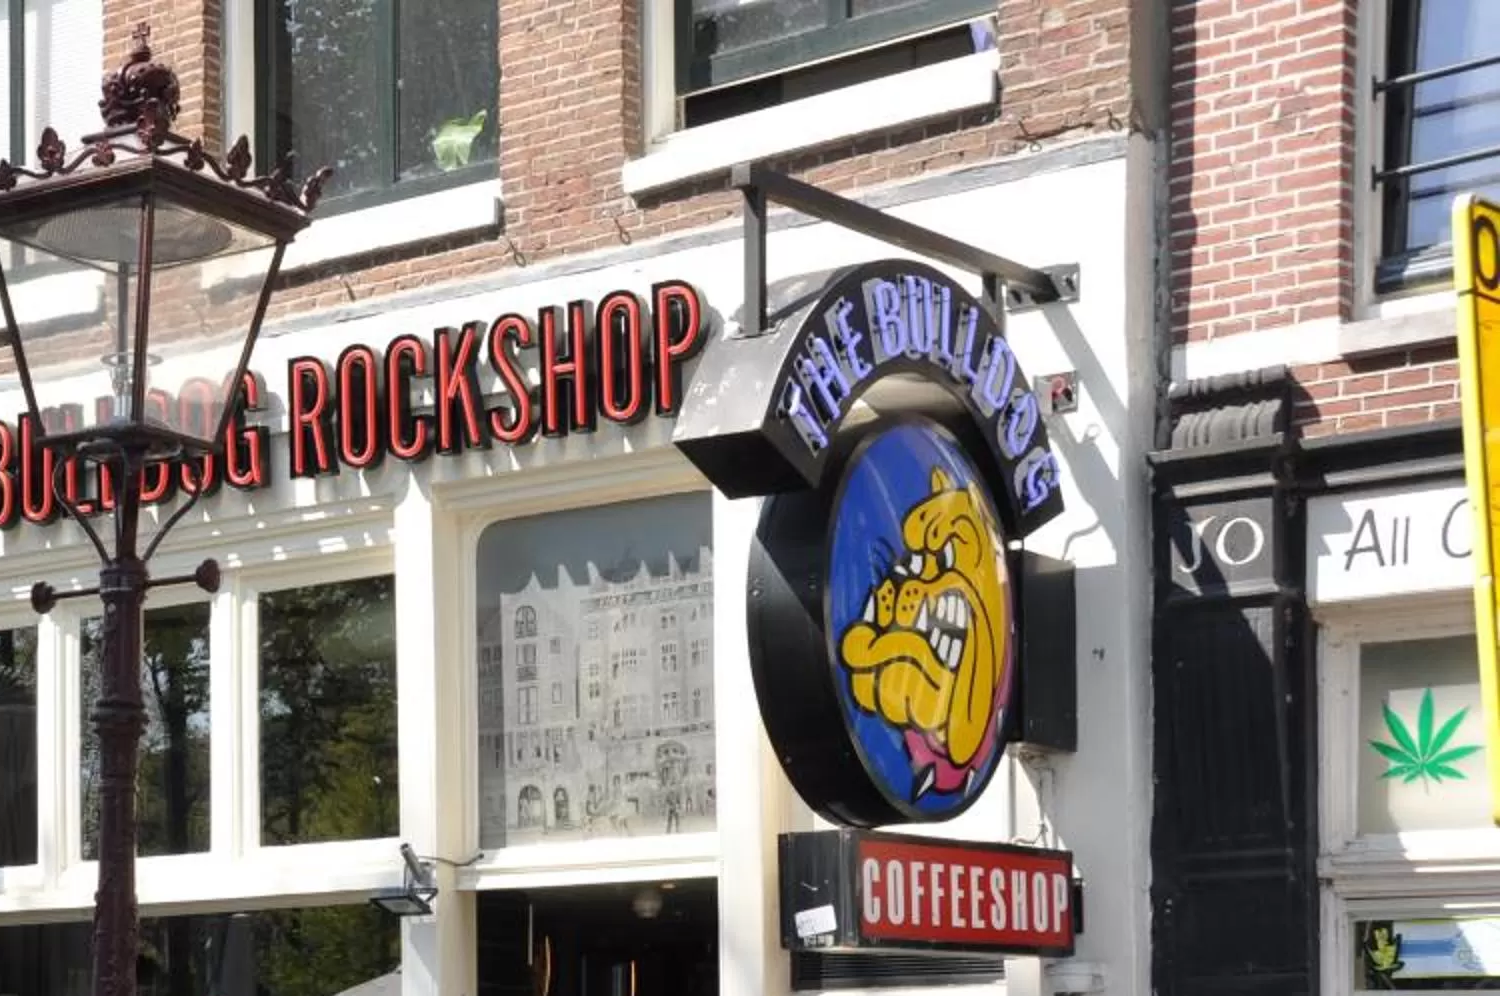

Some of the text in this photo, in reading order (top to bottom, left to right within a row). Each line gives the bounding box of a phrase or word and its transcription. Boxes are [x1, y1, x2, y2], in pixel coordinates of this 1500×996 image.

[288, 279, 706, 478] ROCKSHOP
[776, 273, 1061, 513] THE BULLDOG
[1343, 508, 1411, 572] All
[862, 858, 1069, 933] COFFEESHOP
